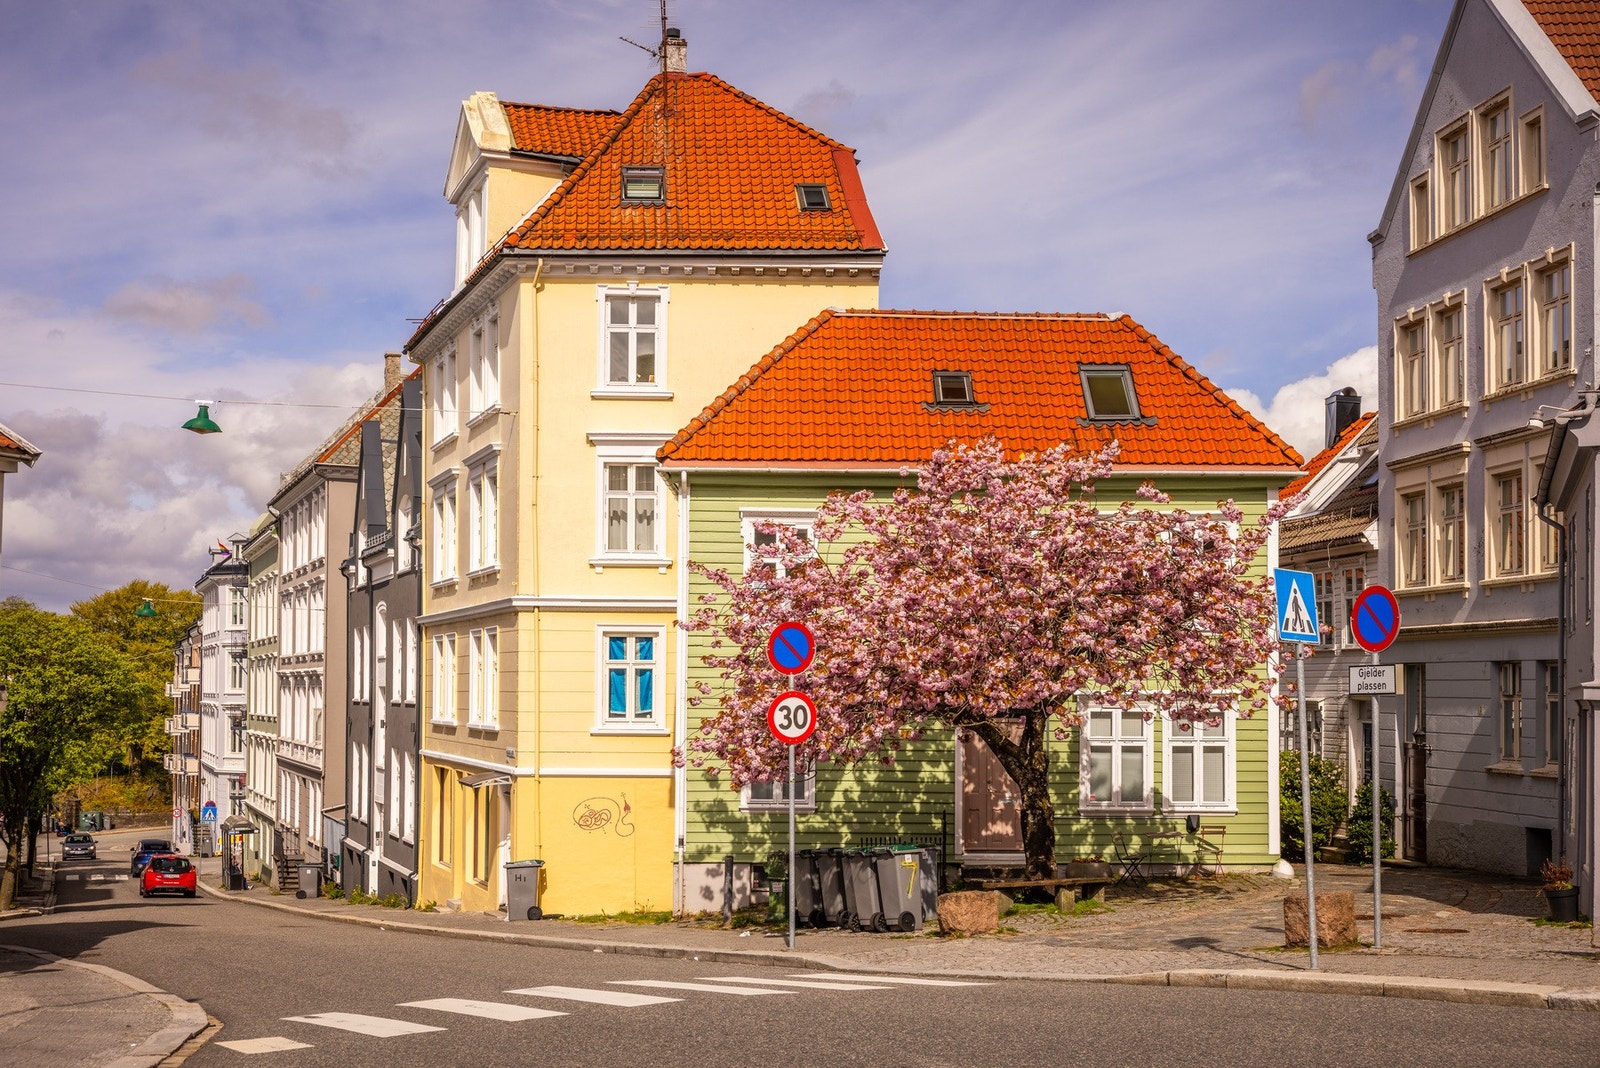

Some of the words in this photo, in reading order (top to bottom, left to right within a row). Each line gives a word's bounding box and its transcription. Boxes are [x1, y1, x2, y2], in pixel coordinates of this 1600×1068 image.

[1358, 667, 1386, 680] Gjelder
[1357, 682, 1387, 692] plassen
[778, 704, 808, 730] 30
